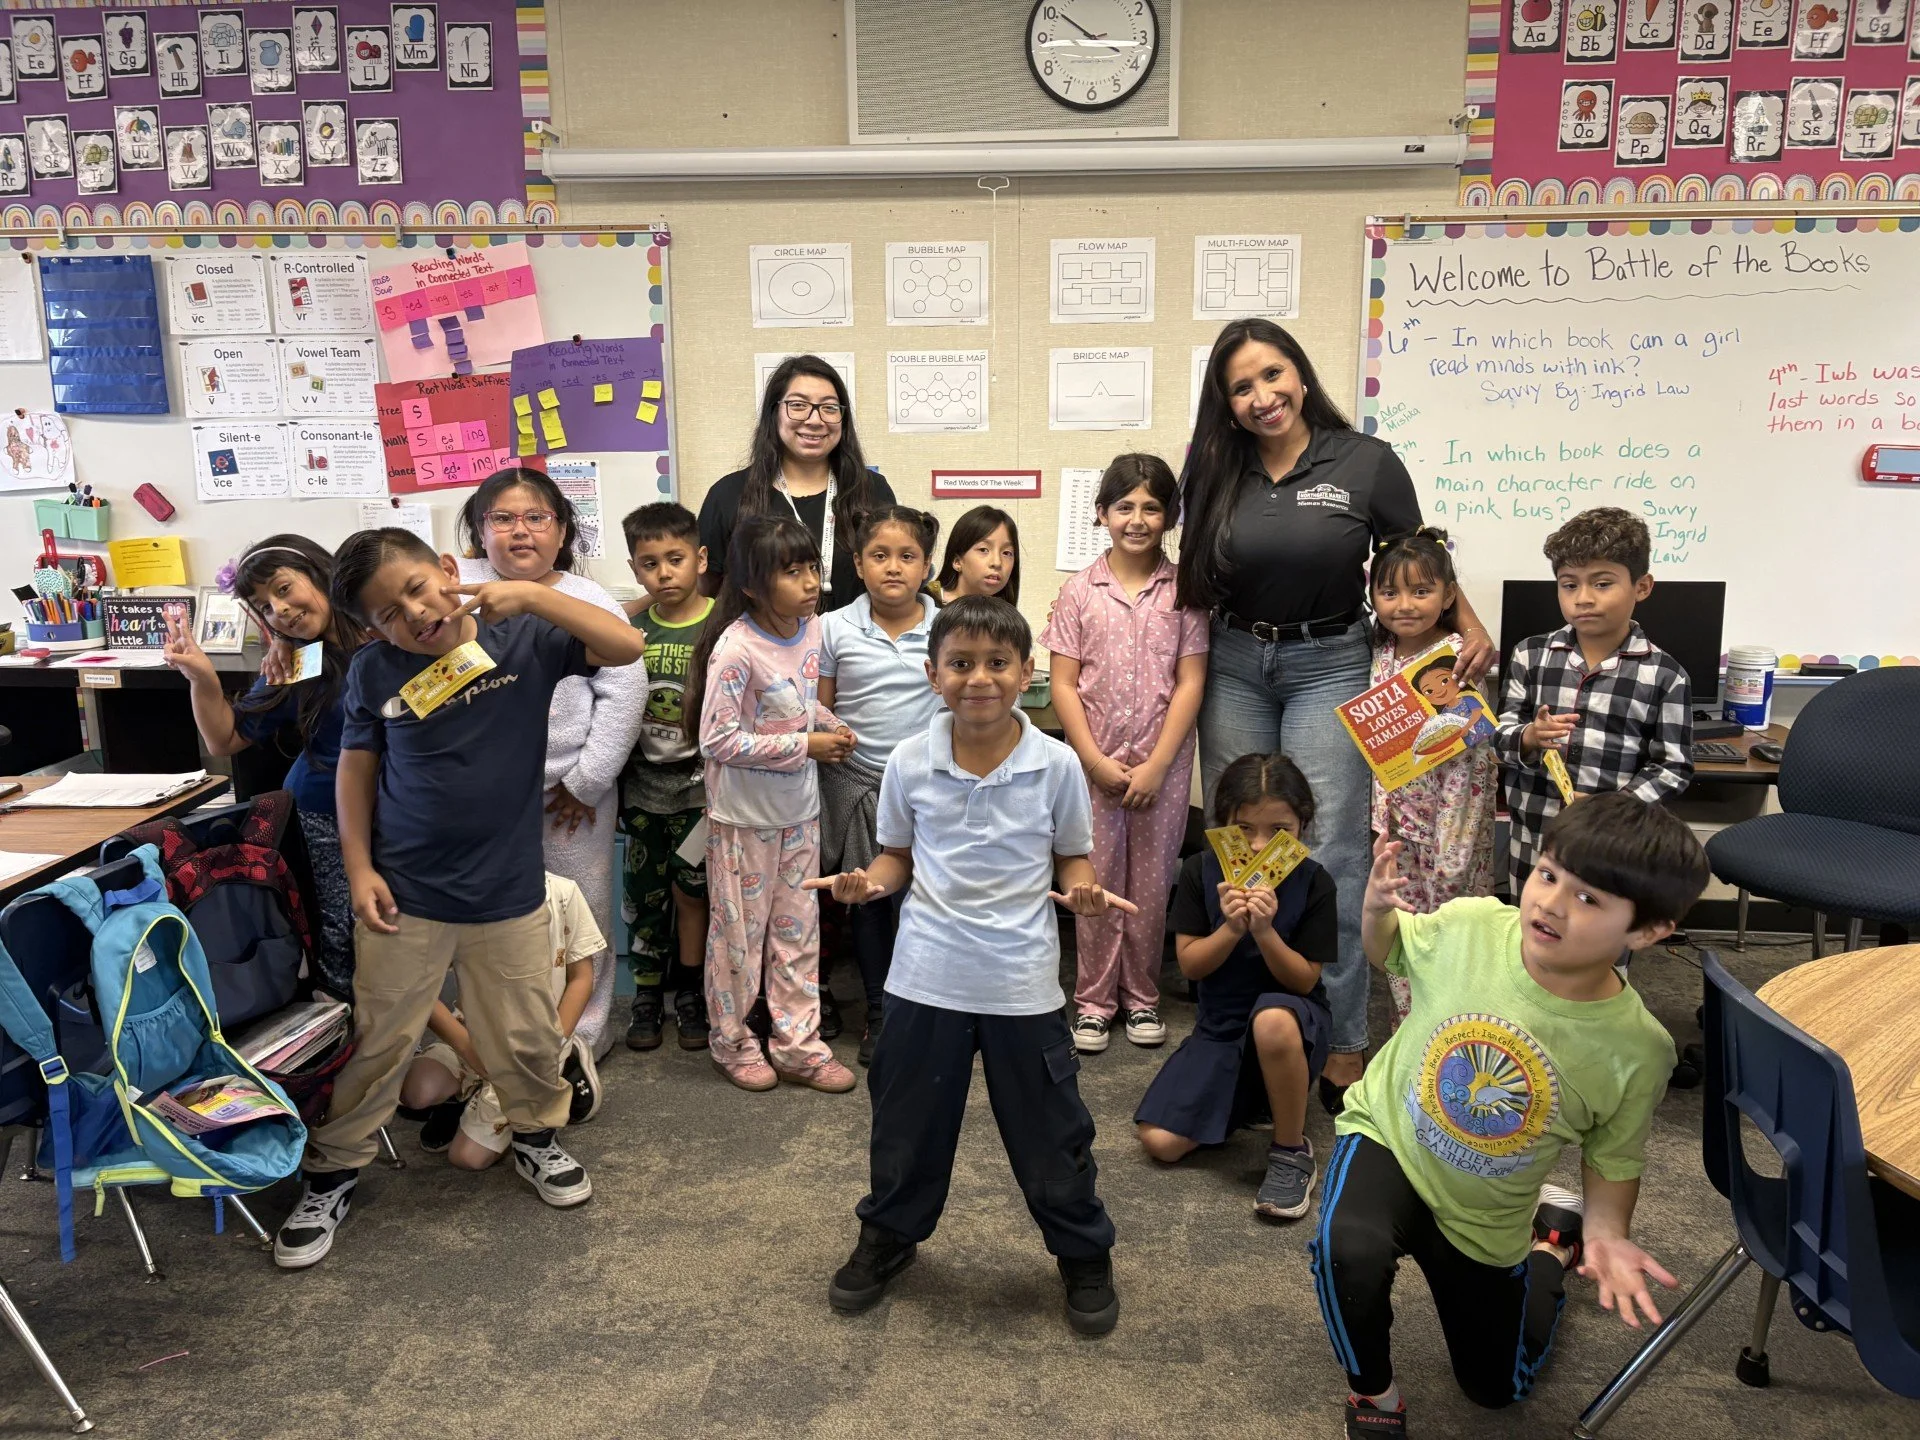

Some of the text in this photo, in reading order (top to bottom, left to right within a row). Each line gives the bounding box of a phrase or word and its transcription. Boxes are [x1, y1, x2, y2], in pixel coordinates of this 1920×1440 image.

[1044, 6, 1056, 20] 10
[1135, 2, 1143, 16] 2
[1639, 23, 1659, 38] Cc
[1752, 21, 1773, 36] Ee
[1869, 17, 1890, 35] Gg
[1037, 32, 1047, 44] 9
[1139, 30, 1148, 46] 3
[1523, 27, 1545, 42] Aa
[1810, 32, 1829, 48] Ff
[1580, 36, 1600, 51] Bb
[1694, 35, 1715, 50] Dd
[403, 45, 428, 59] Mm
[28, 54, 44, 69] Ee
[120, 52, 136, 68] Gg
[1129, 55, 1140, 72] 4
[461, 63, 478, 78] Nn
[1043, 60, 1053, 76] 8
[171, 72, 187, 87] Hh
[1112, 79, 1121, 93] 5
[1063, 80, 1071, 95] 7
[1086, 86, 1097, 101] 6
[1573, 123, 1594, 138] Oo
[1688, 119, 1711, 138] Qq
[1801, 121, 1820, 136] Ss
[1630, 139, 1650, 157] Pp
[1746, 136, 1765, 151] Rr
[1859, 133, 1876, 148] Tt
[371, 158, 387, 172] Zz
[908, 246, 966, 255] BUBBLE MAP
[1078, 242, 1128, 251] FLOW MAP
[1208, 239, 1289, 248] MULTI-FLOW MAP
[774, 248, 827, 257] CIRCLE MAP
[196, 264, 234, 275] Closed
[284, 263, 355, 274] R-Controlled
[412, 251, 485, 274] Reading Words
[1409, 240, 1871, 294] Welcome to Battle of the Books
[415, 264, 494, 288] in Connected Text
[430, 294, 450, 306] -ing
[1452, 327, 1478, 348] In
[1491, 328, 1553, 351] which
[1567, 326, 1614, 351] book
[1630, 333, 1664, 351] can
[1674, 333, 1689, 348] a
[1703, 328, 1741, 358] girl
[214, 349, 243, 361] Open
[296, 346, 361, 358] Vowel Team
[548, 343, 625, 359] Reading Words
[890, 354, 987, 363] DOUBLE BUBBLE MAP
[1073, 351, 1130, 360] BRIDGE MAP
[562, 355, 625, 368] Connected Text
[1429, 354, 1641, 378] read minds with ink?
[1769, 363, 1798, 385] 4th
[1873, 366, 1920, 379] was
[416, 375, 511, 395] Root Words Suffixes
[1479, 381, 1542, 404] Savvy
[1591, 382, 1646, 408] Ingrid
[1658, 381, 1690, 396] Law
[1769, 390, 1808, 412] last
[1819, 388, 1880, 406] words
[379, 406, 402, 416] tree
[1386, 407, 1421, 432] Mishka
[1767, 414, 1884, 434] them in a
[220, 432, 261, 443] Silent-e
[300, 431, 373, 442] Consonant-le
[384, 429, 486, 448] walk ing
[1443, 439, 1472, 465] In
[1487, 443, 1545, 463] which
[1559, 441, 1604, 462] book
[1618, 437, 1670, 459] does
[1688, 443, 1701, 459] a
[388, 456, 492, 478] dance ing
[944, 479, 957, 487] Red
[958, 479, 979, 487] Words
[1004, 479, 1024, 487] Week:
[1435, 469, 1696, 493] main character ride on
[1435, 496, 1571, 522] a pink bus?
[1655, 521, 1708, 550] Ingrid
[1652, 549, 1689, 564] Law
[108, 605, 119, 614] It
[122, 605, 153, 614] takes
[111, 613, 157, 632] heart
[663, 643, 684, 658] THE
[645, 657, 659, 674] RCE
[661, 657, 672, 675] IS
[1349, 681, 1408, 724] SOFIA
[1367, 703, 1408, 733] LOVES
[1365, 710, 1426, 750] TAMALES!
[1444, 1028, 1476, 1047] Respect
[1428, 1121, 1493, 1167] WHITTIER
[1355, 1415, 1402, 1425] SKECHERS
